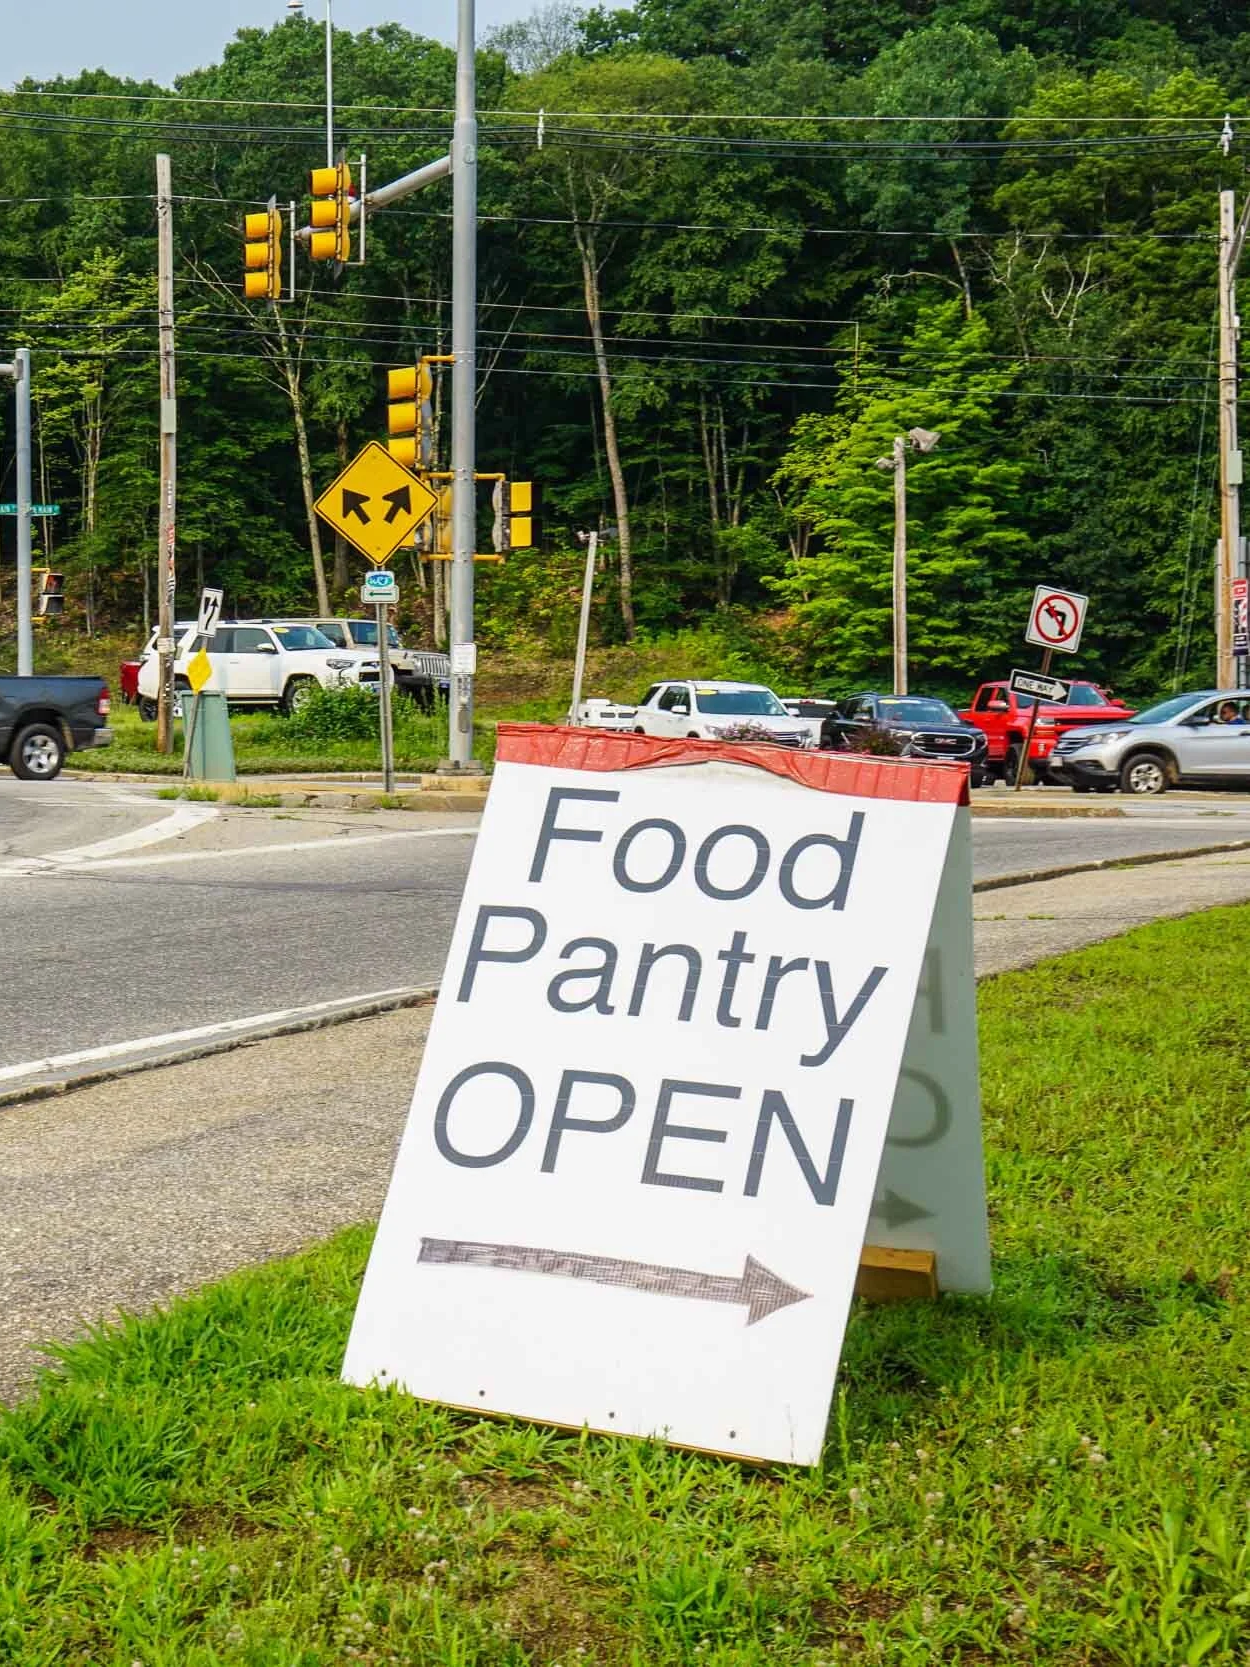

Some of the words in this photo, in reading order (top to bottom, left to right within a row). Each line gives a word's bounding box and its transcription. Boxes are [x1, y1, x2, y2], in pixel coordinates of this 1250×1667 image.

[934, 737, 958, 745] GMC
[1017, 678, 1035, 690] ONE
[1037, 683, 1055, 693] WAY
[528, 786, 866, 911] Food
[456, 904, 889, 1067] Pantry
[433, 1061, 855, 1207] OPEN
